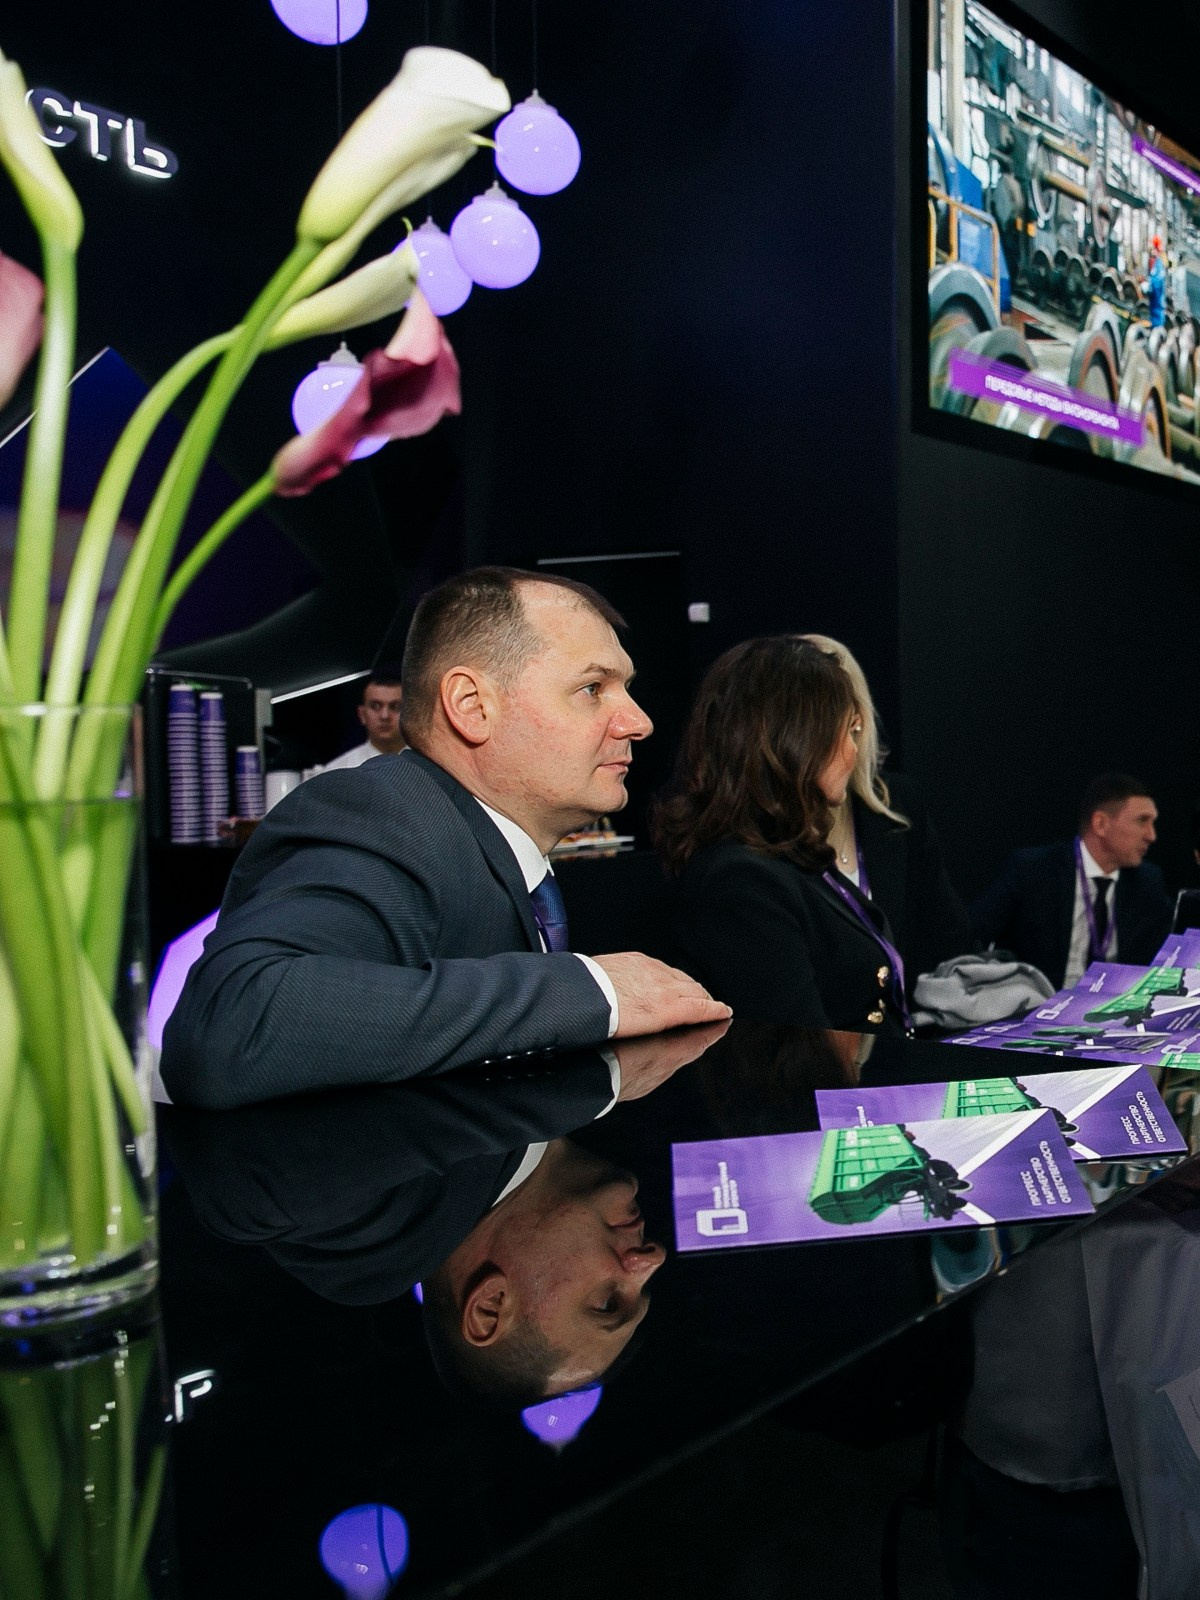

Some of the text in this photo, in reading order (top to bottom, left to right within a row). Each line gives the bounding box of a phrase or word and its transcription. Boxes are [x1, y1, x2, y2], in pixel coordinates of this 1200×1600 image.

[1120, 1116, 1141, 1145] ПРОГРЕСС
[1129, 1105, 1154, 1144] ПАРТНЕРСТВО
[1136, 1091, 1167, 1143] ОТВЕТСТВЕННОСТЬ
